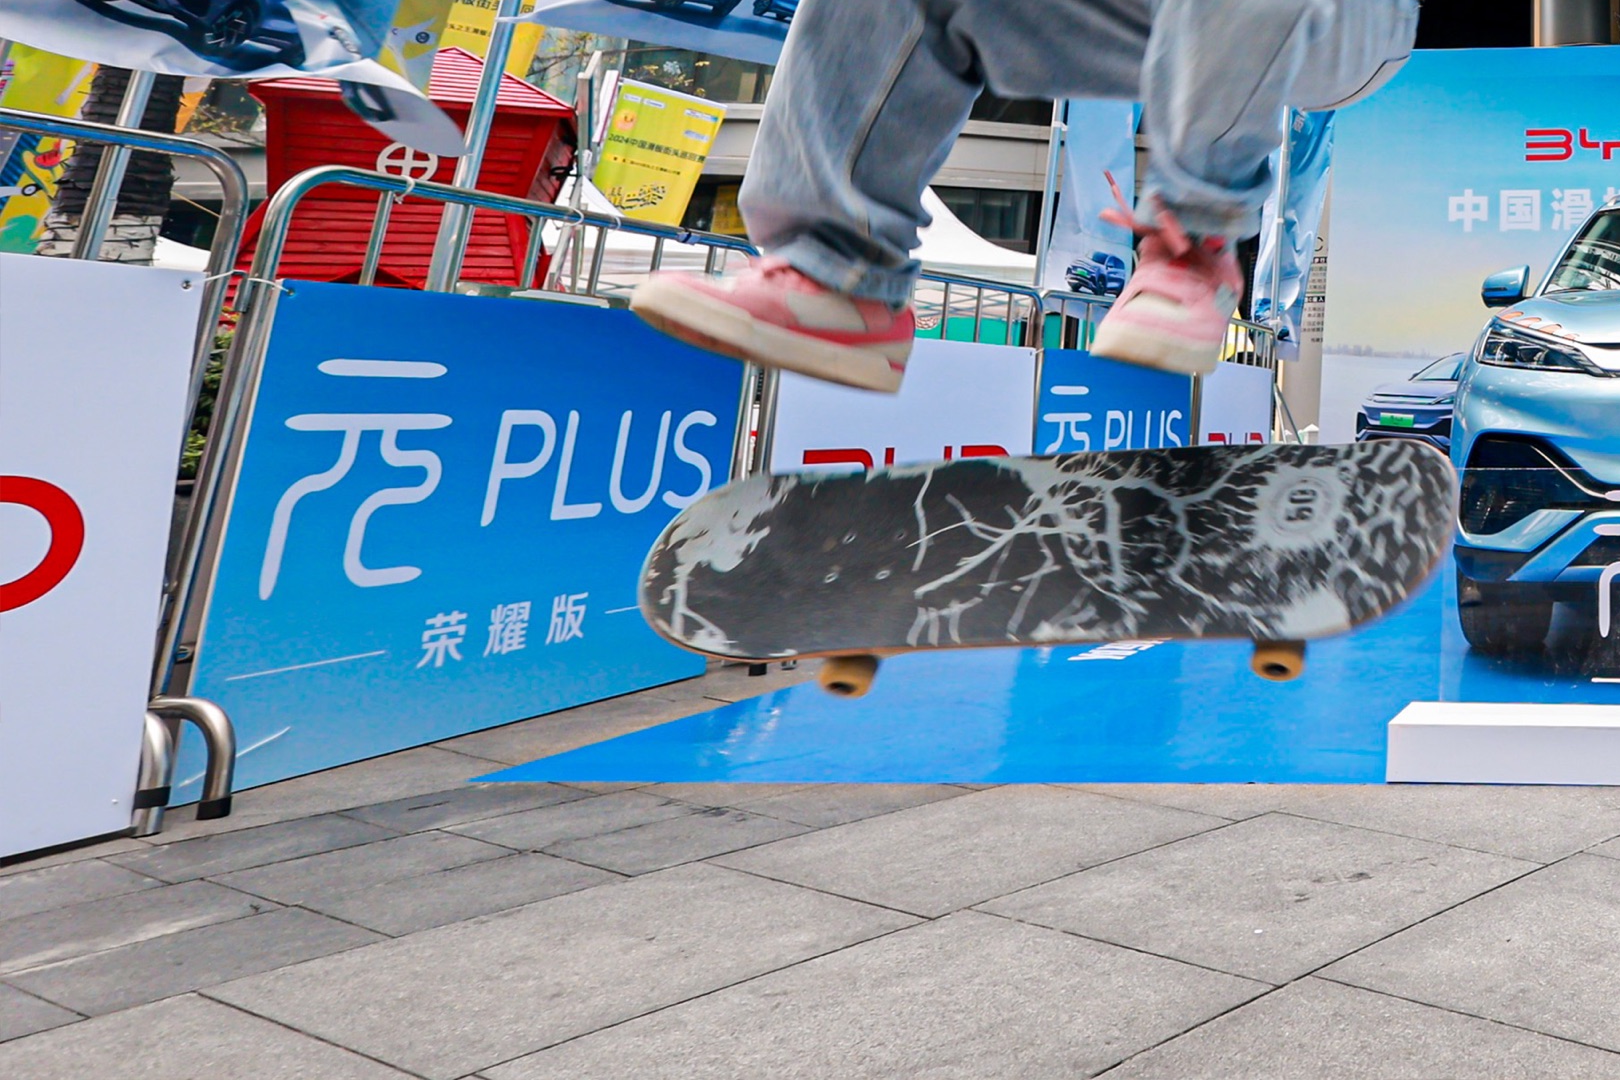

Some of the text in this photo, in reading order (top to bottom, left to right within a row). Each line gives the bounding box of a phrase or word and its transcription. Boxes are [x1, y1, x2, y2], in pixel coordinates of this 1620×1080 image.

[480, 410, 717, 527] PLUS
[416, 591, 590, 671] 荣耀版
